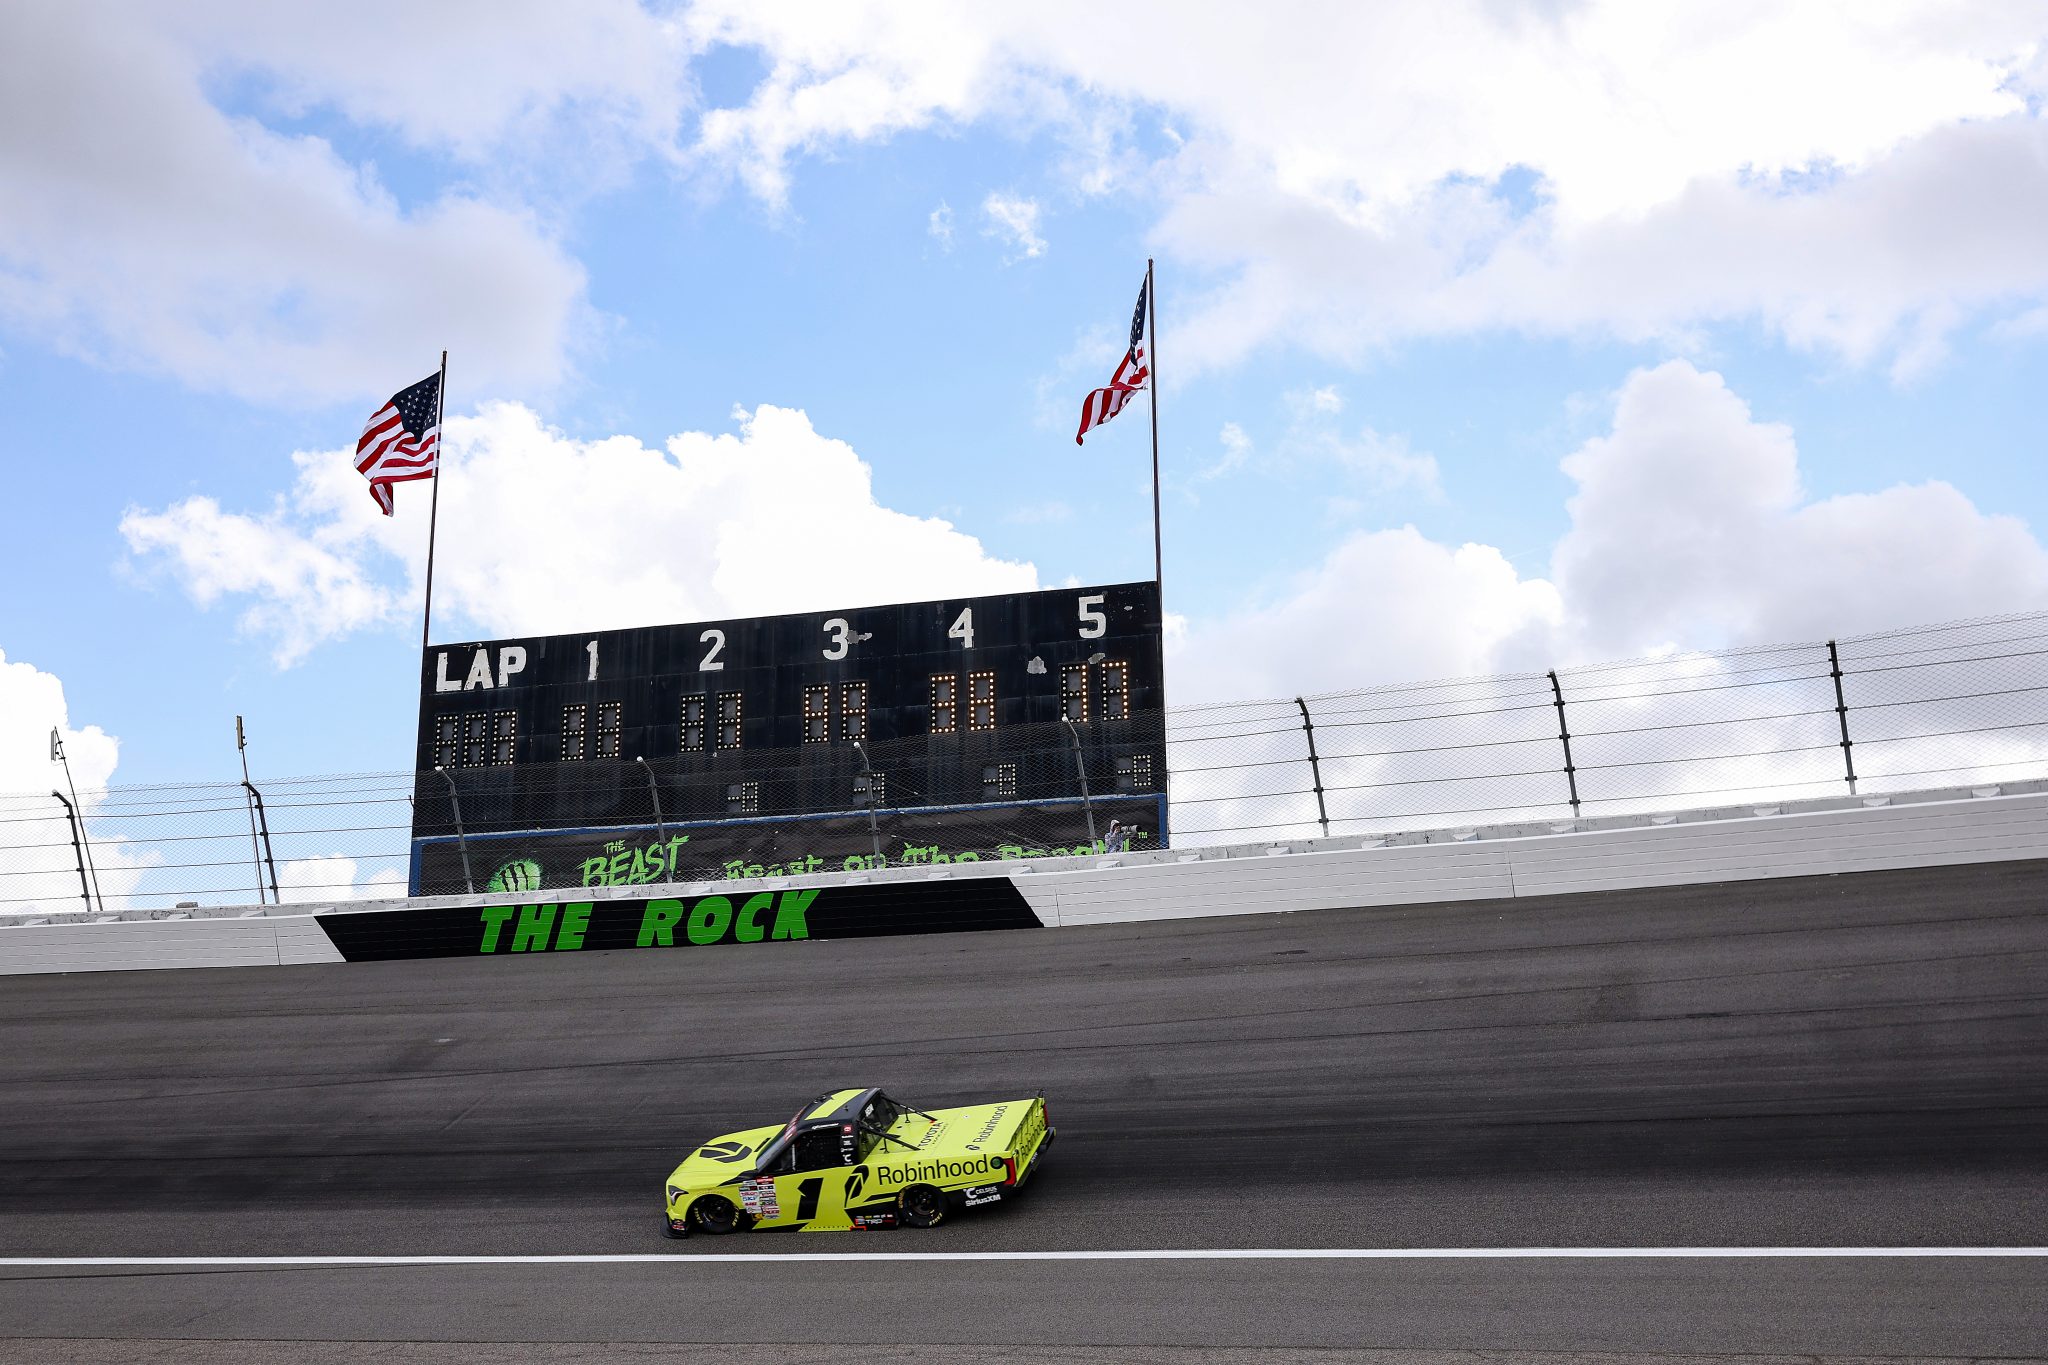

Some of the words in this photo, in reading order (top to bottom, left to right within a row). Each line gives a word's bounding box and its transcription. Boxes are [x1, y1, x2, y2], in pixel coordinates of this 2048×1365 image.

[435, 646, 527, 693] LAP
[586, 640, 599, 681] 1
[699, 629, 727, 672] 2
[822, 618, 849, 660] 3
[949, 608, 975, 648] 4
[1078, 595, 1107, 639] 5
[577, 834, 689, 887] BEAST
[604, 839, 626, 854] THE
[480, 903, 594, 952] THE
[636, 889, 821, 947] ROCK
[972, 1105, 1008, 1143] Robinhood
[877, 1154, 989, 1185] Robinhood
[796, 1177, 824, 1220] 1
[965, 1193, 1001, 1207] SiriusXM
